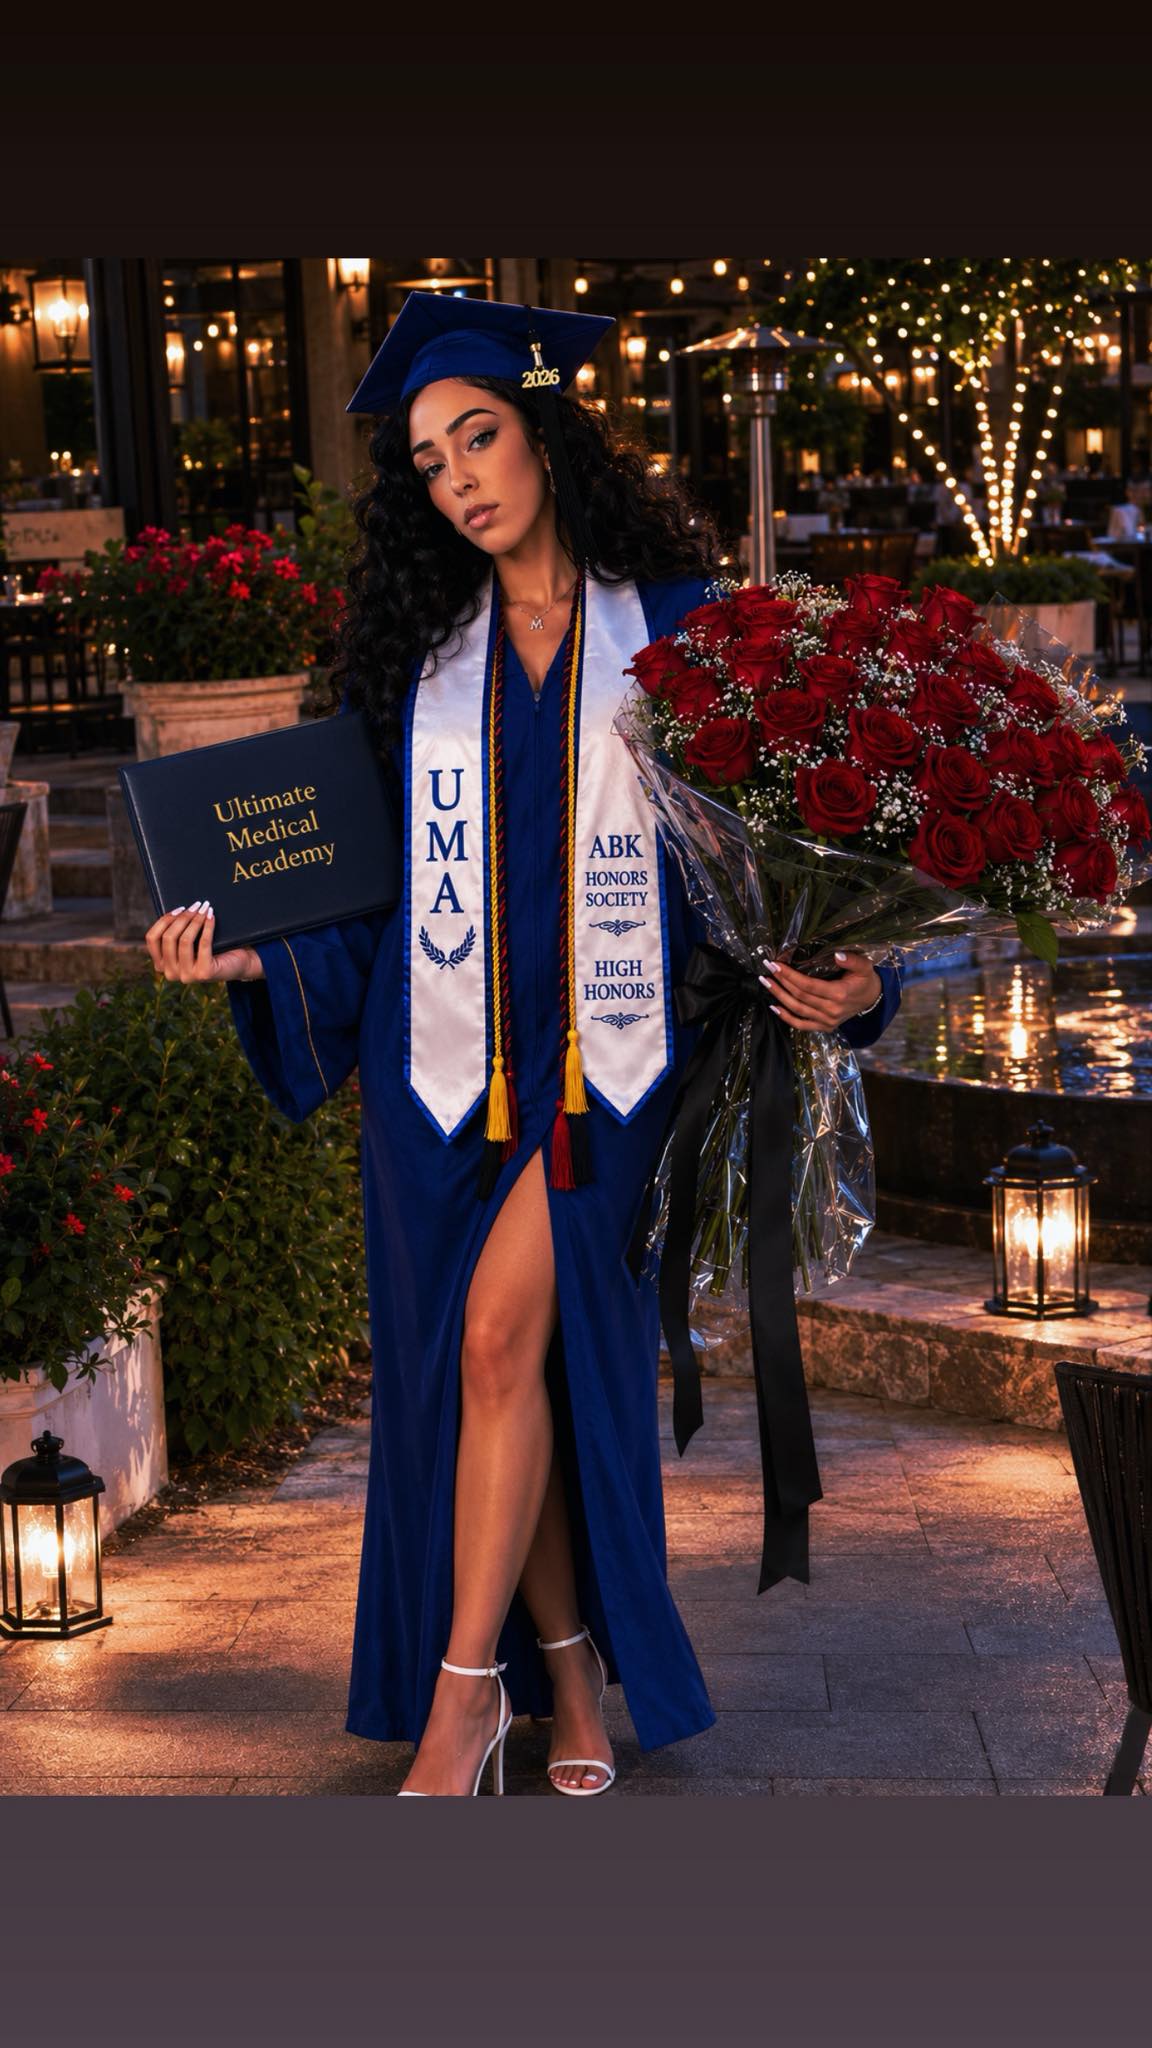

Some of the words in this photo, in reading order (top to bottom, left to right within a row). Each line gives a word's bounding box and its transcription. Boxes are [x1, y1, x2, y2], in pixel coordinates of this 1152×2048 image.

[522, 368, 560, 388] 2026
[530, 618, 544, 630] M
[213, 784, 317, 824] Ultimate
[226, 809, 320, 853] Medical
[588, 834, 644, 859] ABK
[232, 843, 335, 883] Academy
[585, 870, 648, 886] HONORS
[585, 891, 648, 907] SOCIETY
[595, 959, 643, 977] HIGH
[584, 983, 655, 1001] HONORS
